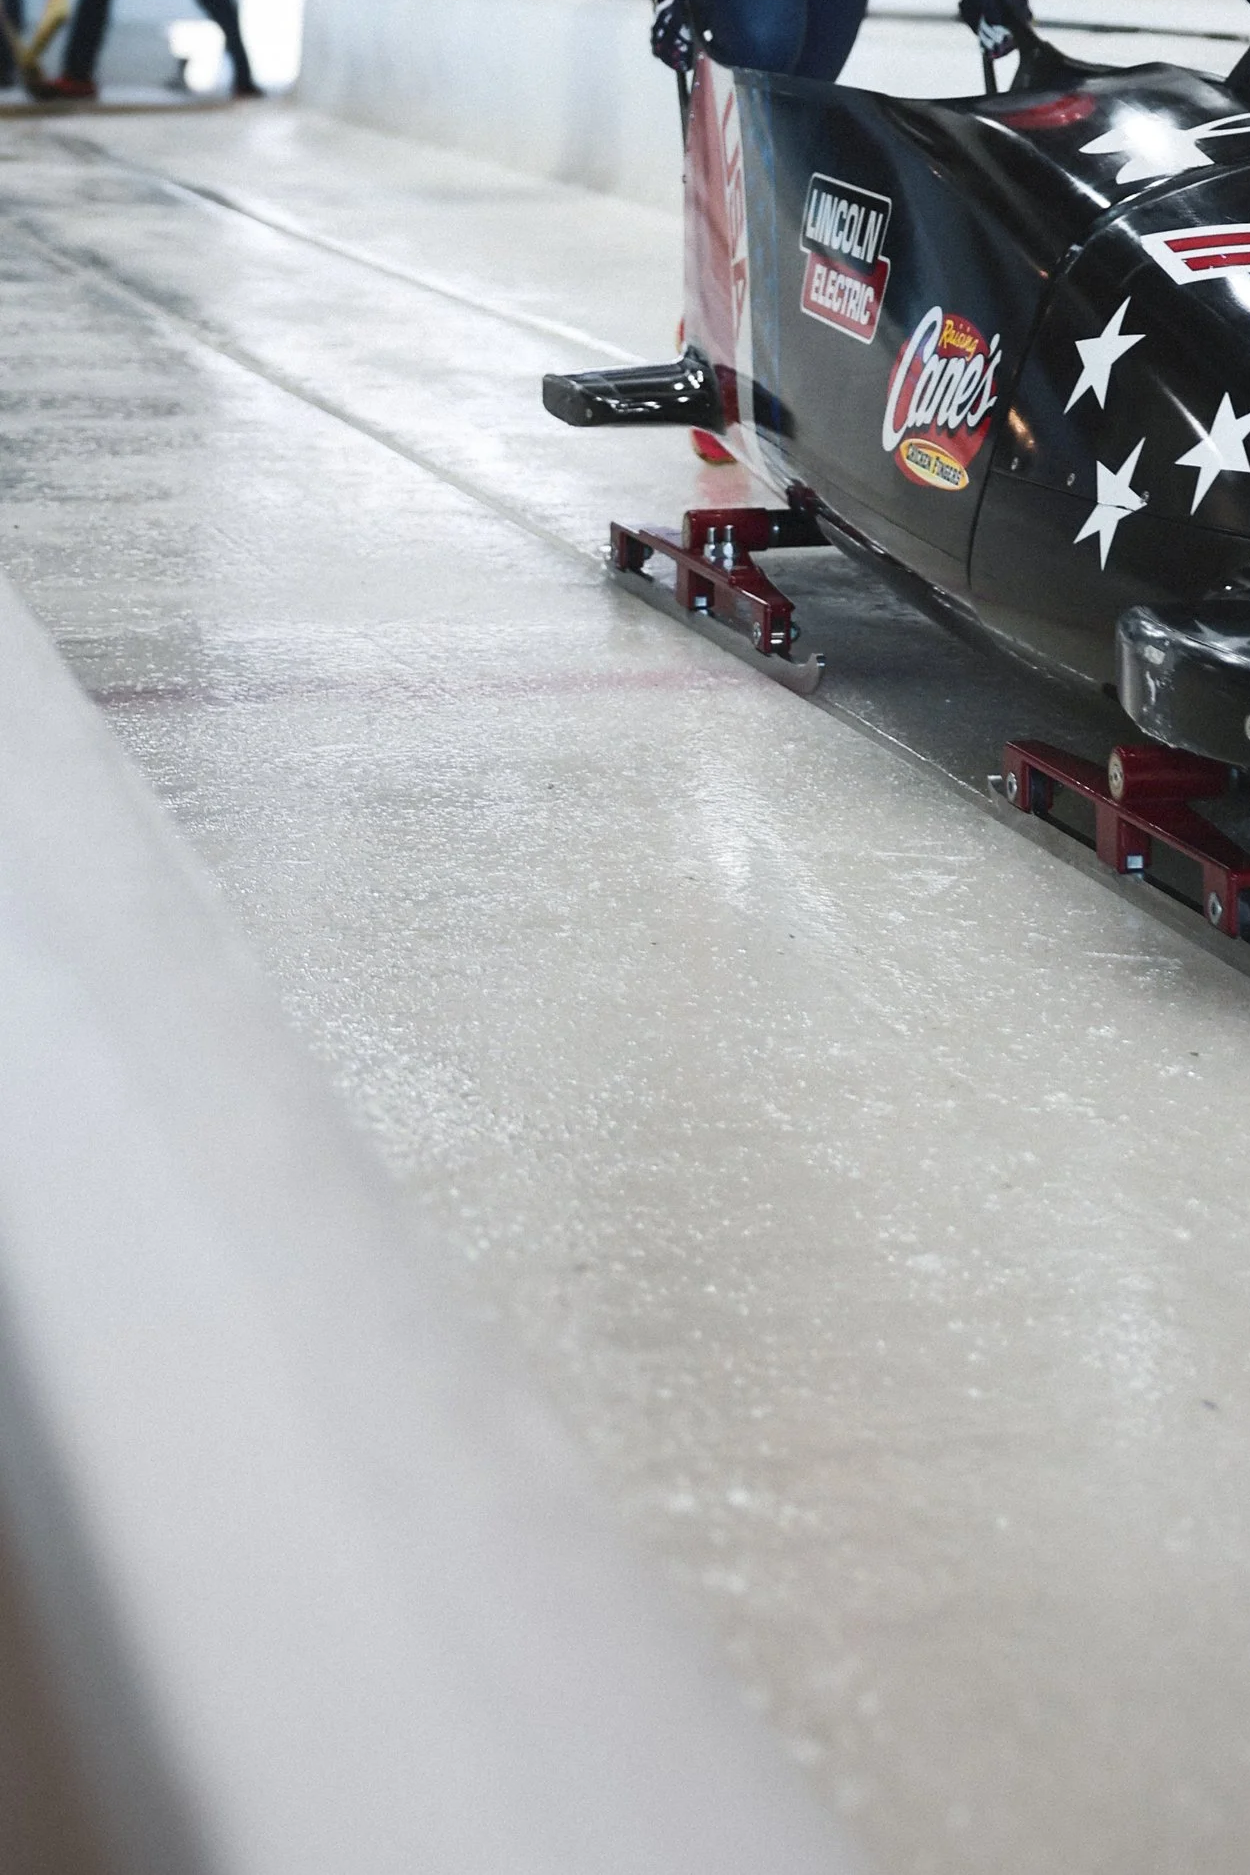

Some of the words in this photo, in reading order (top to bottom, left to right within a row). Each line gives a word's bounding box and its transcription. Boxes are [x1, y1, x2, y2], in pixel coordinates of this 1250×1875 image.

[805, 188, 884, 265] LINCOLN
[810, 263, 875, 326] ELECTRIC
[882, 305, 1002, 452] Cane's
